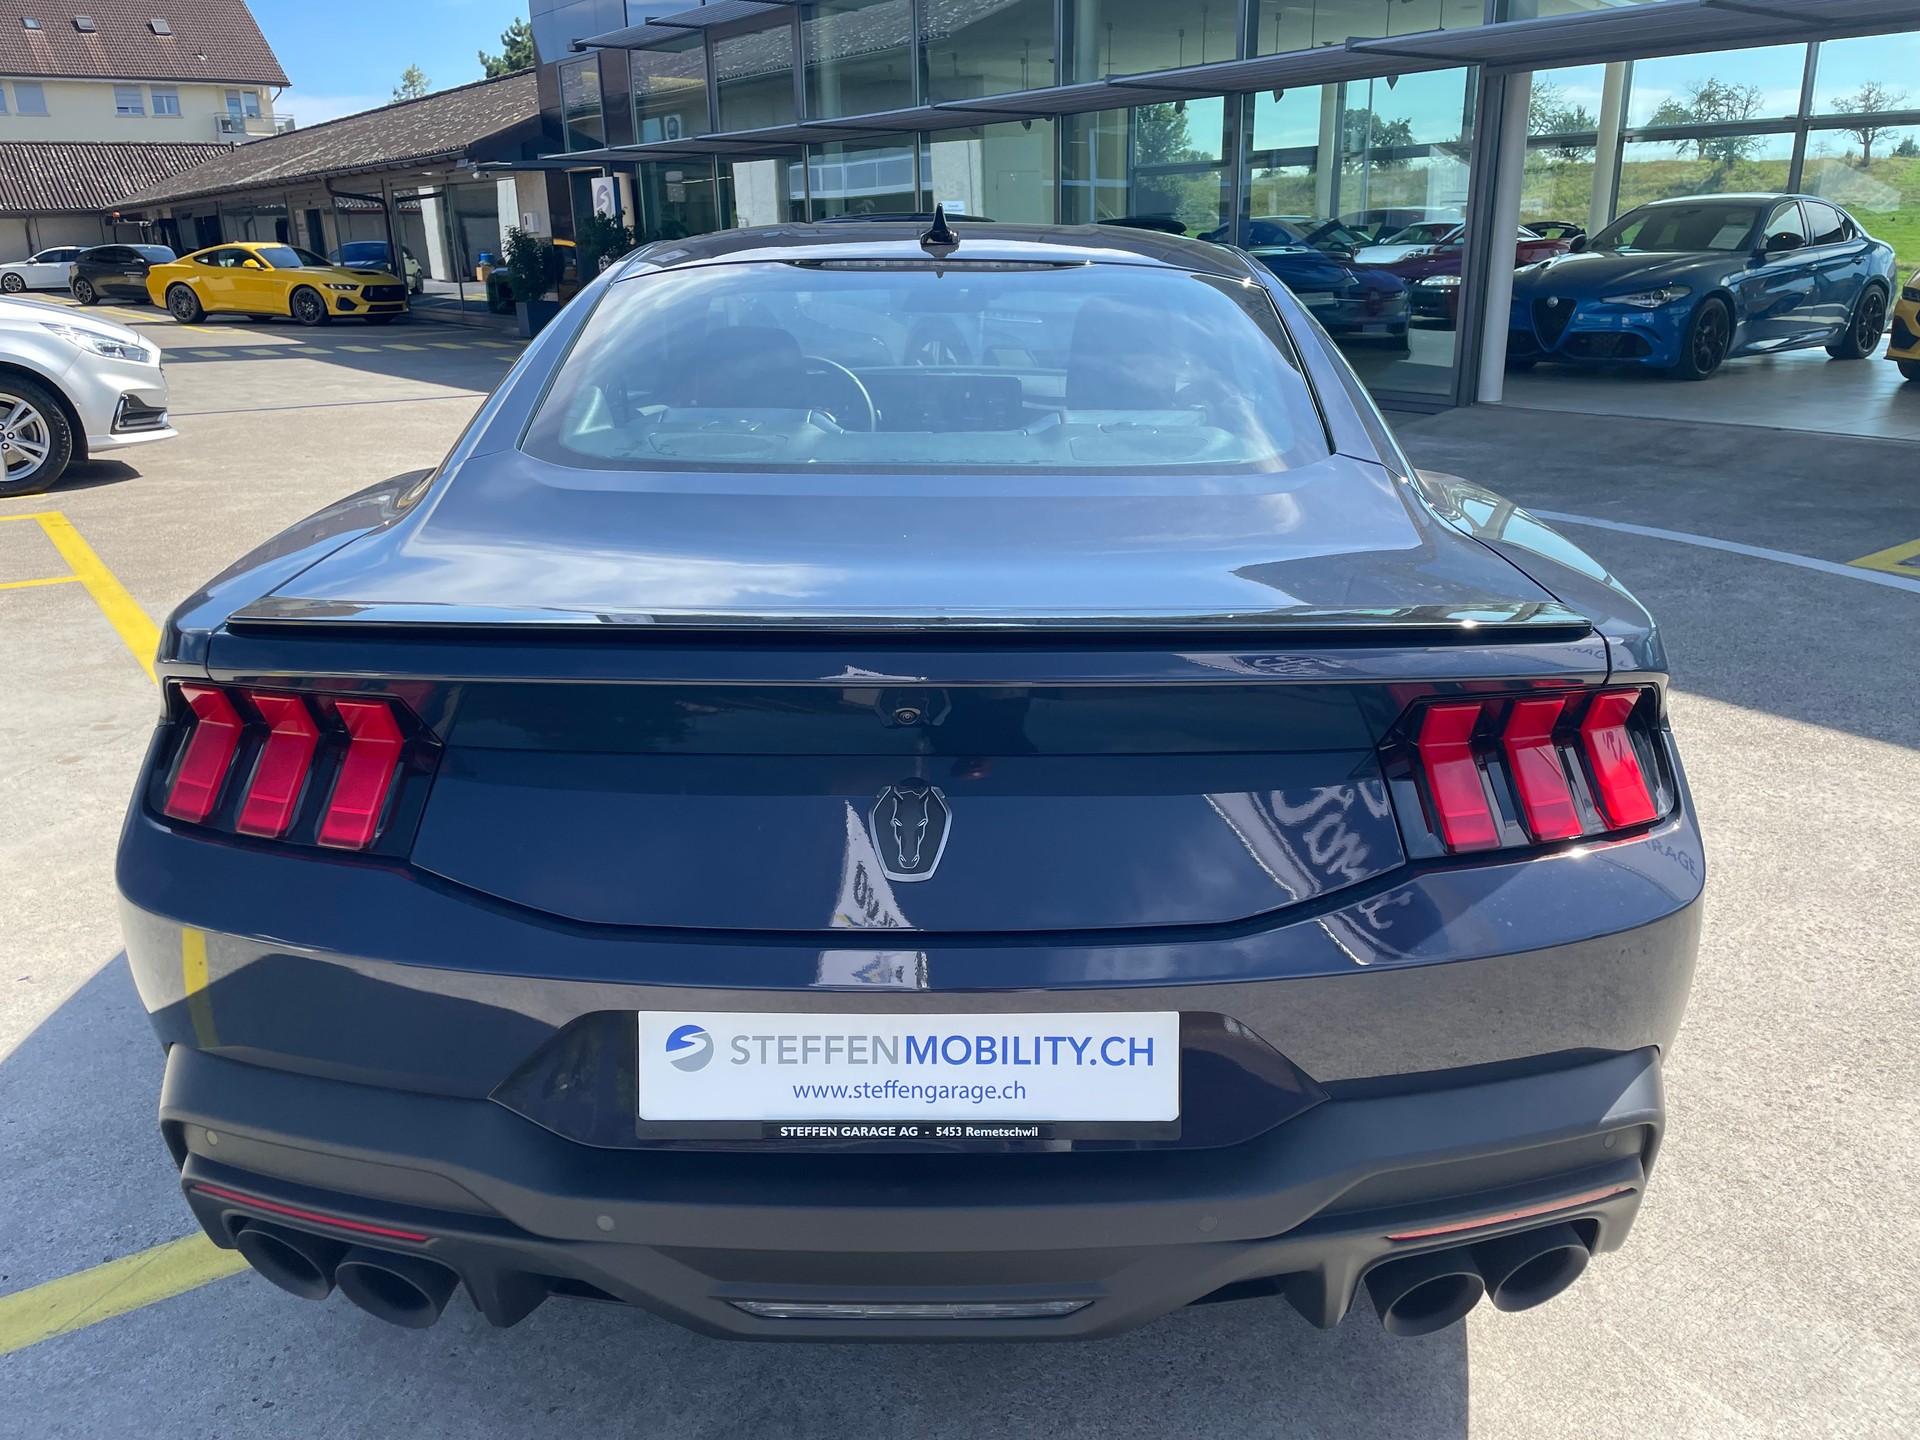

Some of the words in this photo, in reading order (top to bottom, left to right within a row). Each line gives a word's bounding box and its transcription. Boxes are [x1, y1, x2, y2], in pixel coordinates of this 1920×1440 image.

[730, 1034, 1154, 1066] STEFFENMOBILITY.CH
[792, 1079, 1026, 1104] www.steffengarage.ch
[780, 1126, 838, 1137] STEFFEN
[840, 1126, 896, 1137] GARAGE
[899, 1126, 919, 1137] AG
[935, 1126, 962, 1137] 5453
[965, 1126, 1039, 1137] Remetschwil
